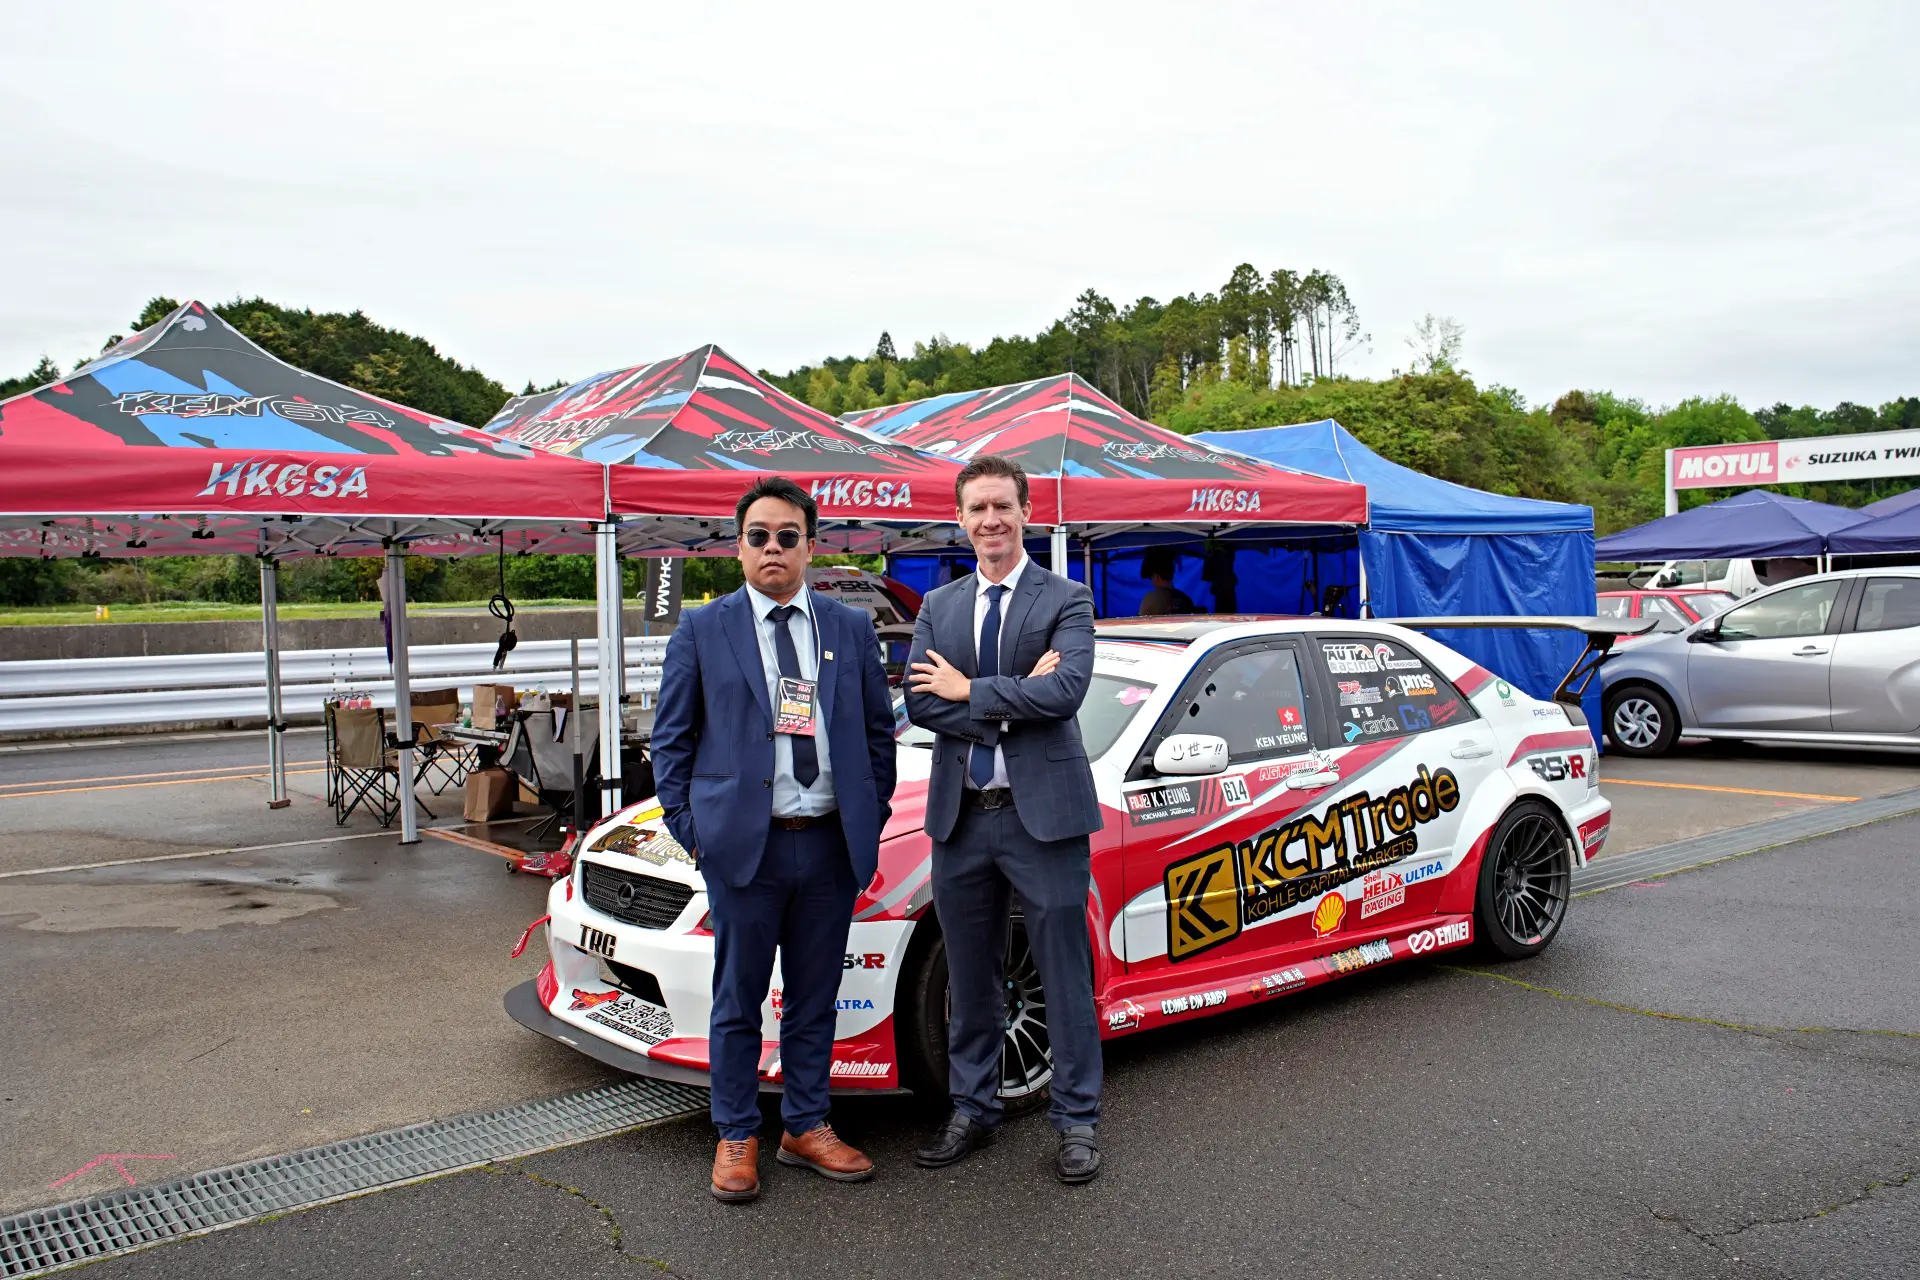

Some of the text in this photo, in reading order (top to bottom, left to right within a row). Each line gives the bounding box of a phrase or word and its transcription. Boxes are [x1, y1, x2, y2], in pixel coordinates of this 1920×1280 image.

[113, 391, 395, 428] KEN 614
[712, 428, 811, 452] KEN
[1678, 452, 1774, 479] MOTUL
[1808, 450, 1877, 465] SUZUKA
[200, 460, 368, 498] HKGSA
[811, 478, 912, 507] HKGSA
[1187, 487, 1260, 512] HKGSA
[654, 556, 672, 617] OHAMA
[1256, 732, 1307, 748] KEN YEUNG
[1260, 765, 1290, 781] AGM
[1150, 786, 1191, 807] K.YEUNG
[1224, 782, 1247, 802] 614
[1140, 810, 1168, 820] YOKOHAMA
[1247, 838, 1415, 919] KOHLE CAPITAL MARKETS
[1363, 870, 1382, 885] Shell
[1363, 861, 1443, 901] HELIX ULTRA
[1364, 891, 1403, 915] RACING
[1434, 921, 1469, 946] ENKEI
[836, 999, 875, 1010] LTRA
[1161, 989, 1228, 1015] COME ON BABY
[1109, 1011, 1127, 1026] MS
[829, 1060, 891, 1076] Rainbow
